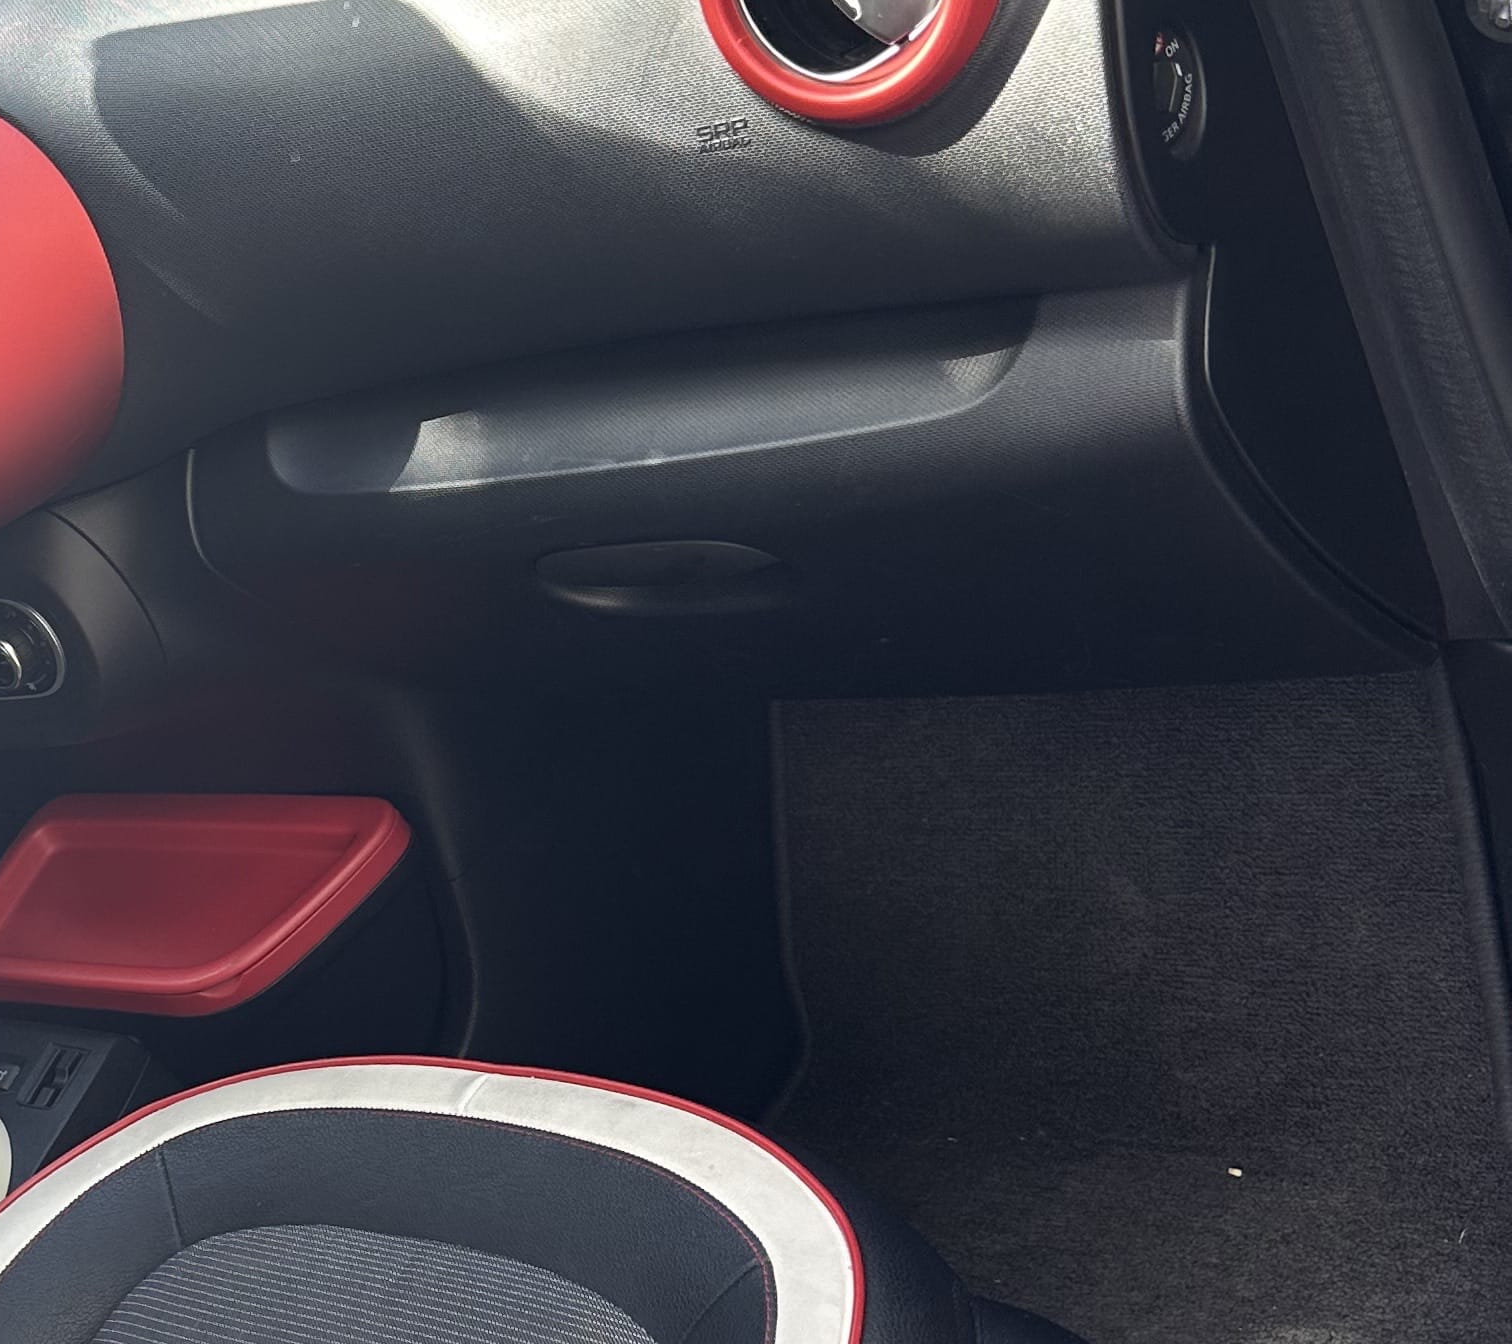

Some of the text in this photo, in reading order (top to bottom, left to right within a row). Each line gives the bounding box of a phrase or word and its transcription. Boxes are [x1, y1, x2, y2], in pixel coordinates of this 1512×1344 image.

[1165, 38, 1180, 57] ON
[1178, 73, 1193, 124] AIRBAG
[696, 117, 749, 142] SRP
